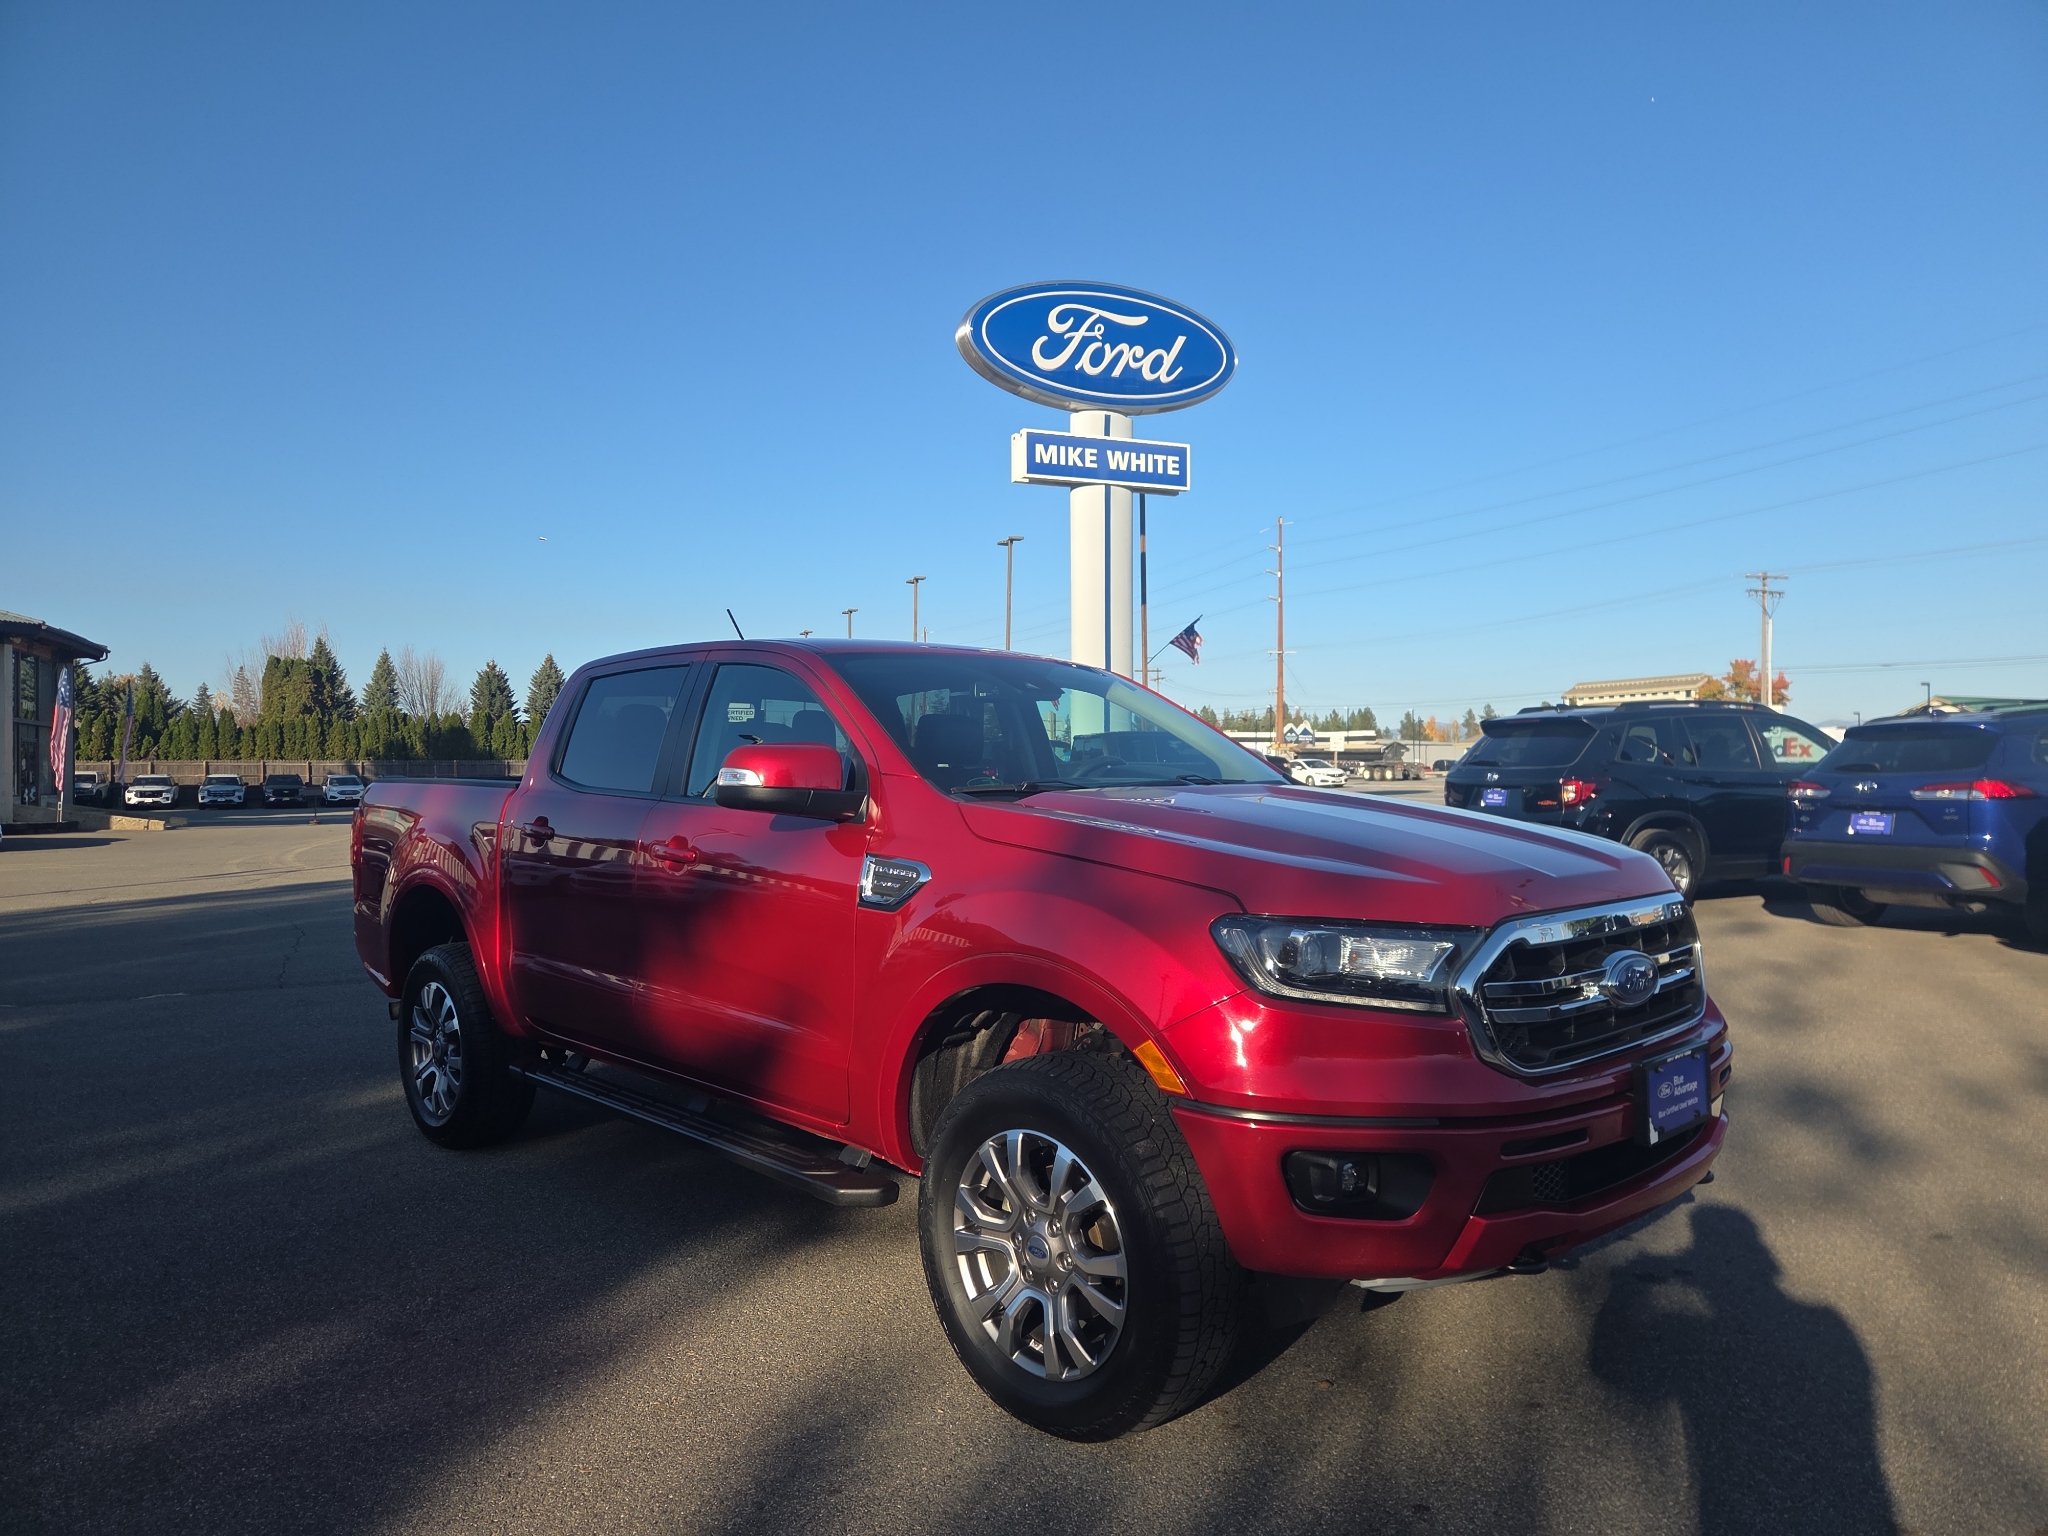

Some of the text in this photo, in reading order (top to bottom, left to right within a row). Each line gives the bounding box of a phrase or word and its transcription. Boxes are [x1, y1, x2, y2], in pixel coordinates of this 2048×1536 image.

[1031, 303, 1187, 383] Ford
[1035, 443, 1180, 476] MIKE WHITE
[1772, 737, 1813, 758] dEx
[875, 865, 917, 878] RANGER
[1673, 1075, 1684, 1085] Blue
[1673, 1081, 1698, 1096] Advantage
